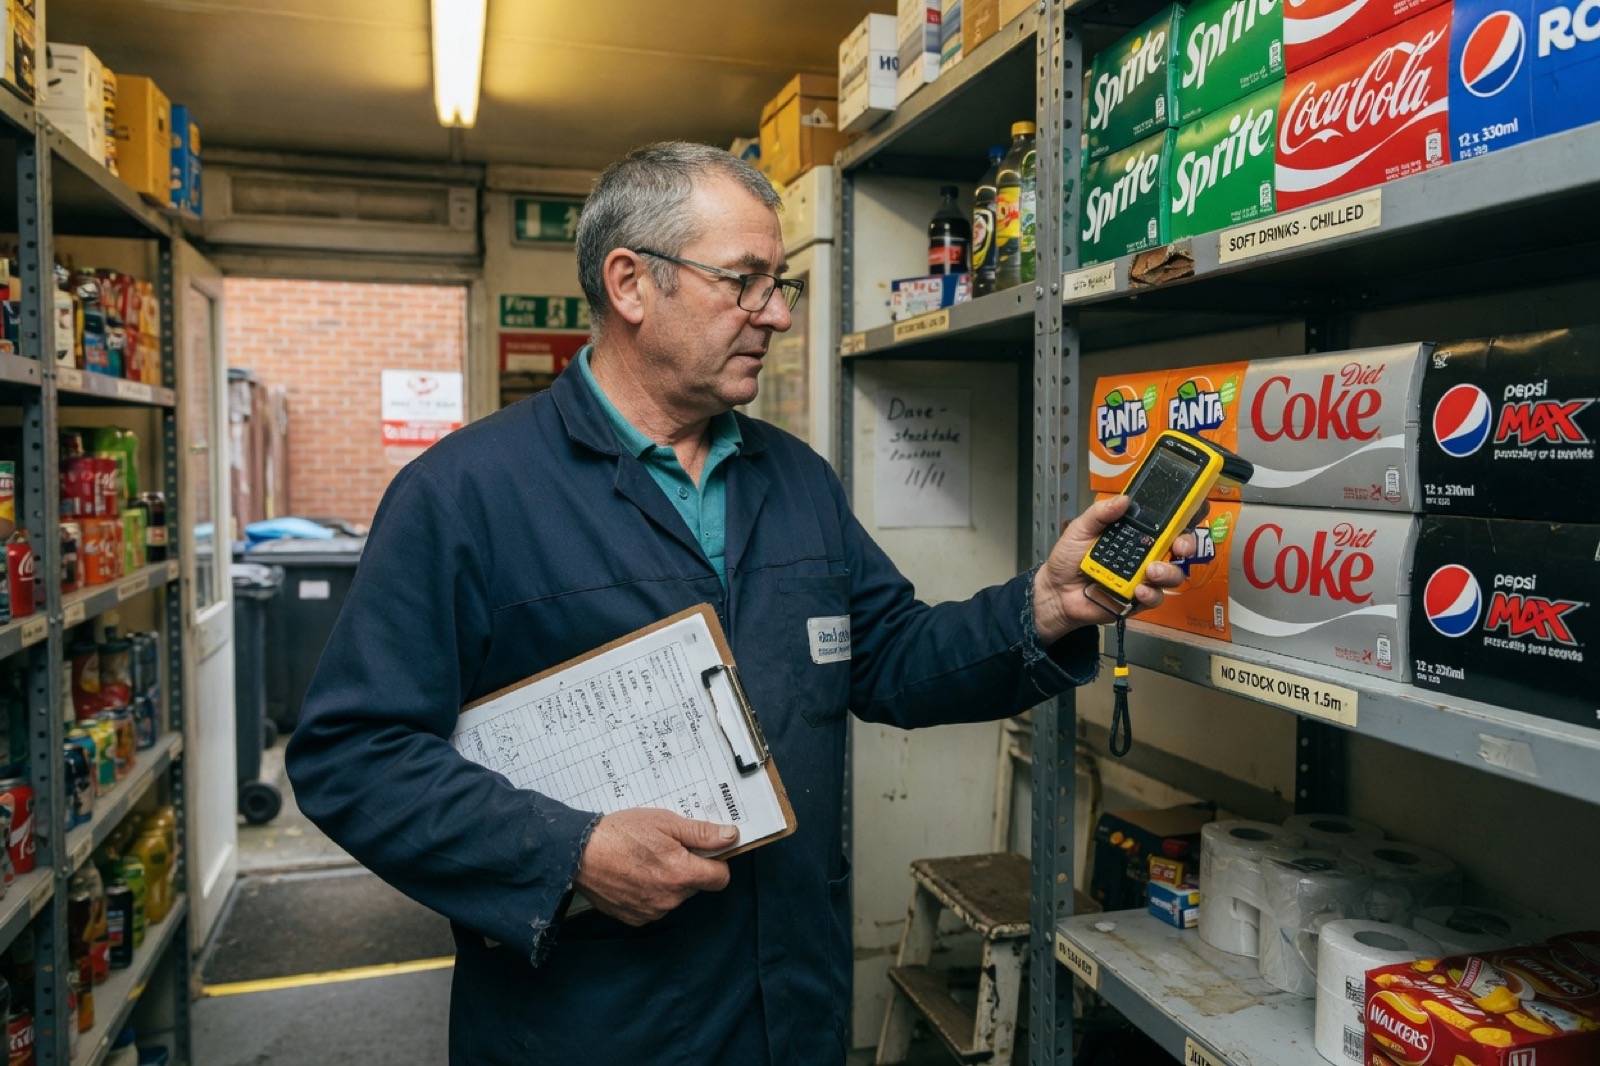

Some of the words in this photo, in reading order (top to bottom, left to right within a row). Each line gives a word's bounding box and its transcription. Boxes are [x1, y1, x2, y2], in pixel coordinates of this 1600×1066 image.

[1090, 30, 1166, 130] Sprite
[1280, 24, 1449, 155] Coca-Cola
[1458, 132, 1471, 147] 12
[1472, 133, 1480, 143] x
[1482, 117, 1519, 141] 330ml
[1172, 108, 1274, 217] Sprite
[1082, 150, 1160, 244] Sprite
[1229, 232, 1256, 252] SOFT
[1258, 220, 1300, 244] DRINKS
[1309, 204, 1364, 231] CHILLED
[1340, 362, 1386, 387] Diet
[1504, 379, 1549, 401] pepsi
[1097, 401, 1148, 439] FANTA
[1168, 392, 1225, 430] FANTA
[1250, 374, 1382, 442] Coke
[1494, 399, 1592, 446] MAX
[1332, 522, 1378, 548] Diet
[1242, 523, 1375, 604] Coke
[1494, 574, 1537, 591] pepsi
[1483, 591, 1584, 647] MAX
[1221, 665, 1236, 680] NO
[1238, 670, 1275, 692] STOCK
[1277, 681, 1310, 702] OVER
[1314, 691, 1342, 711] 1.5m
[1371, 1004, 1429, 1051] WALKERS
